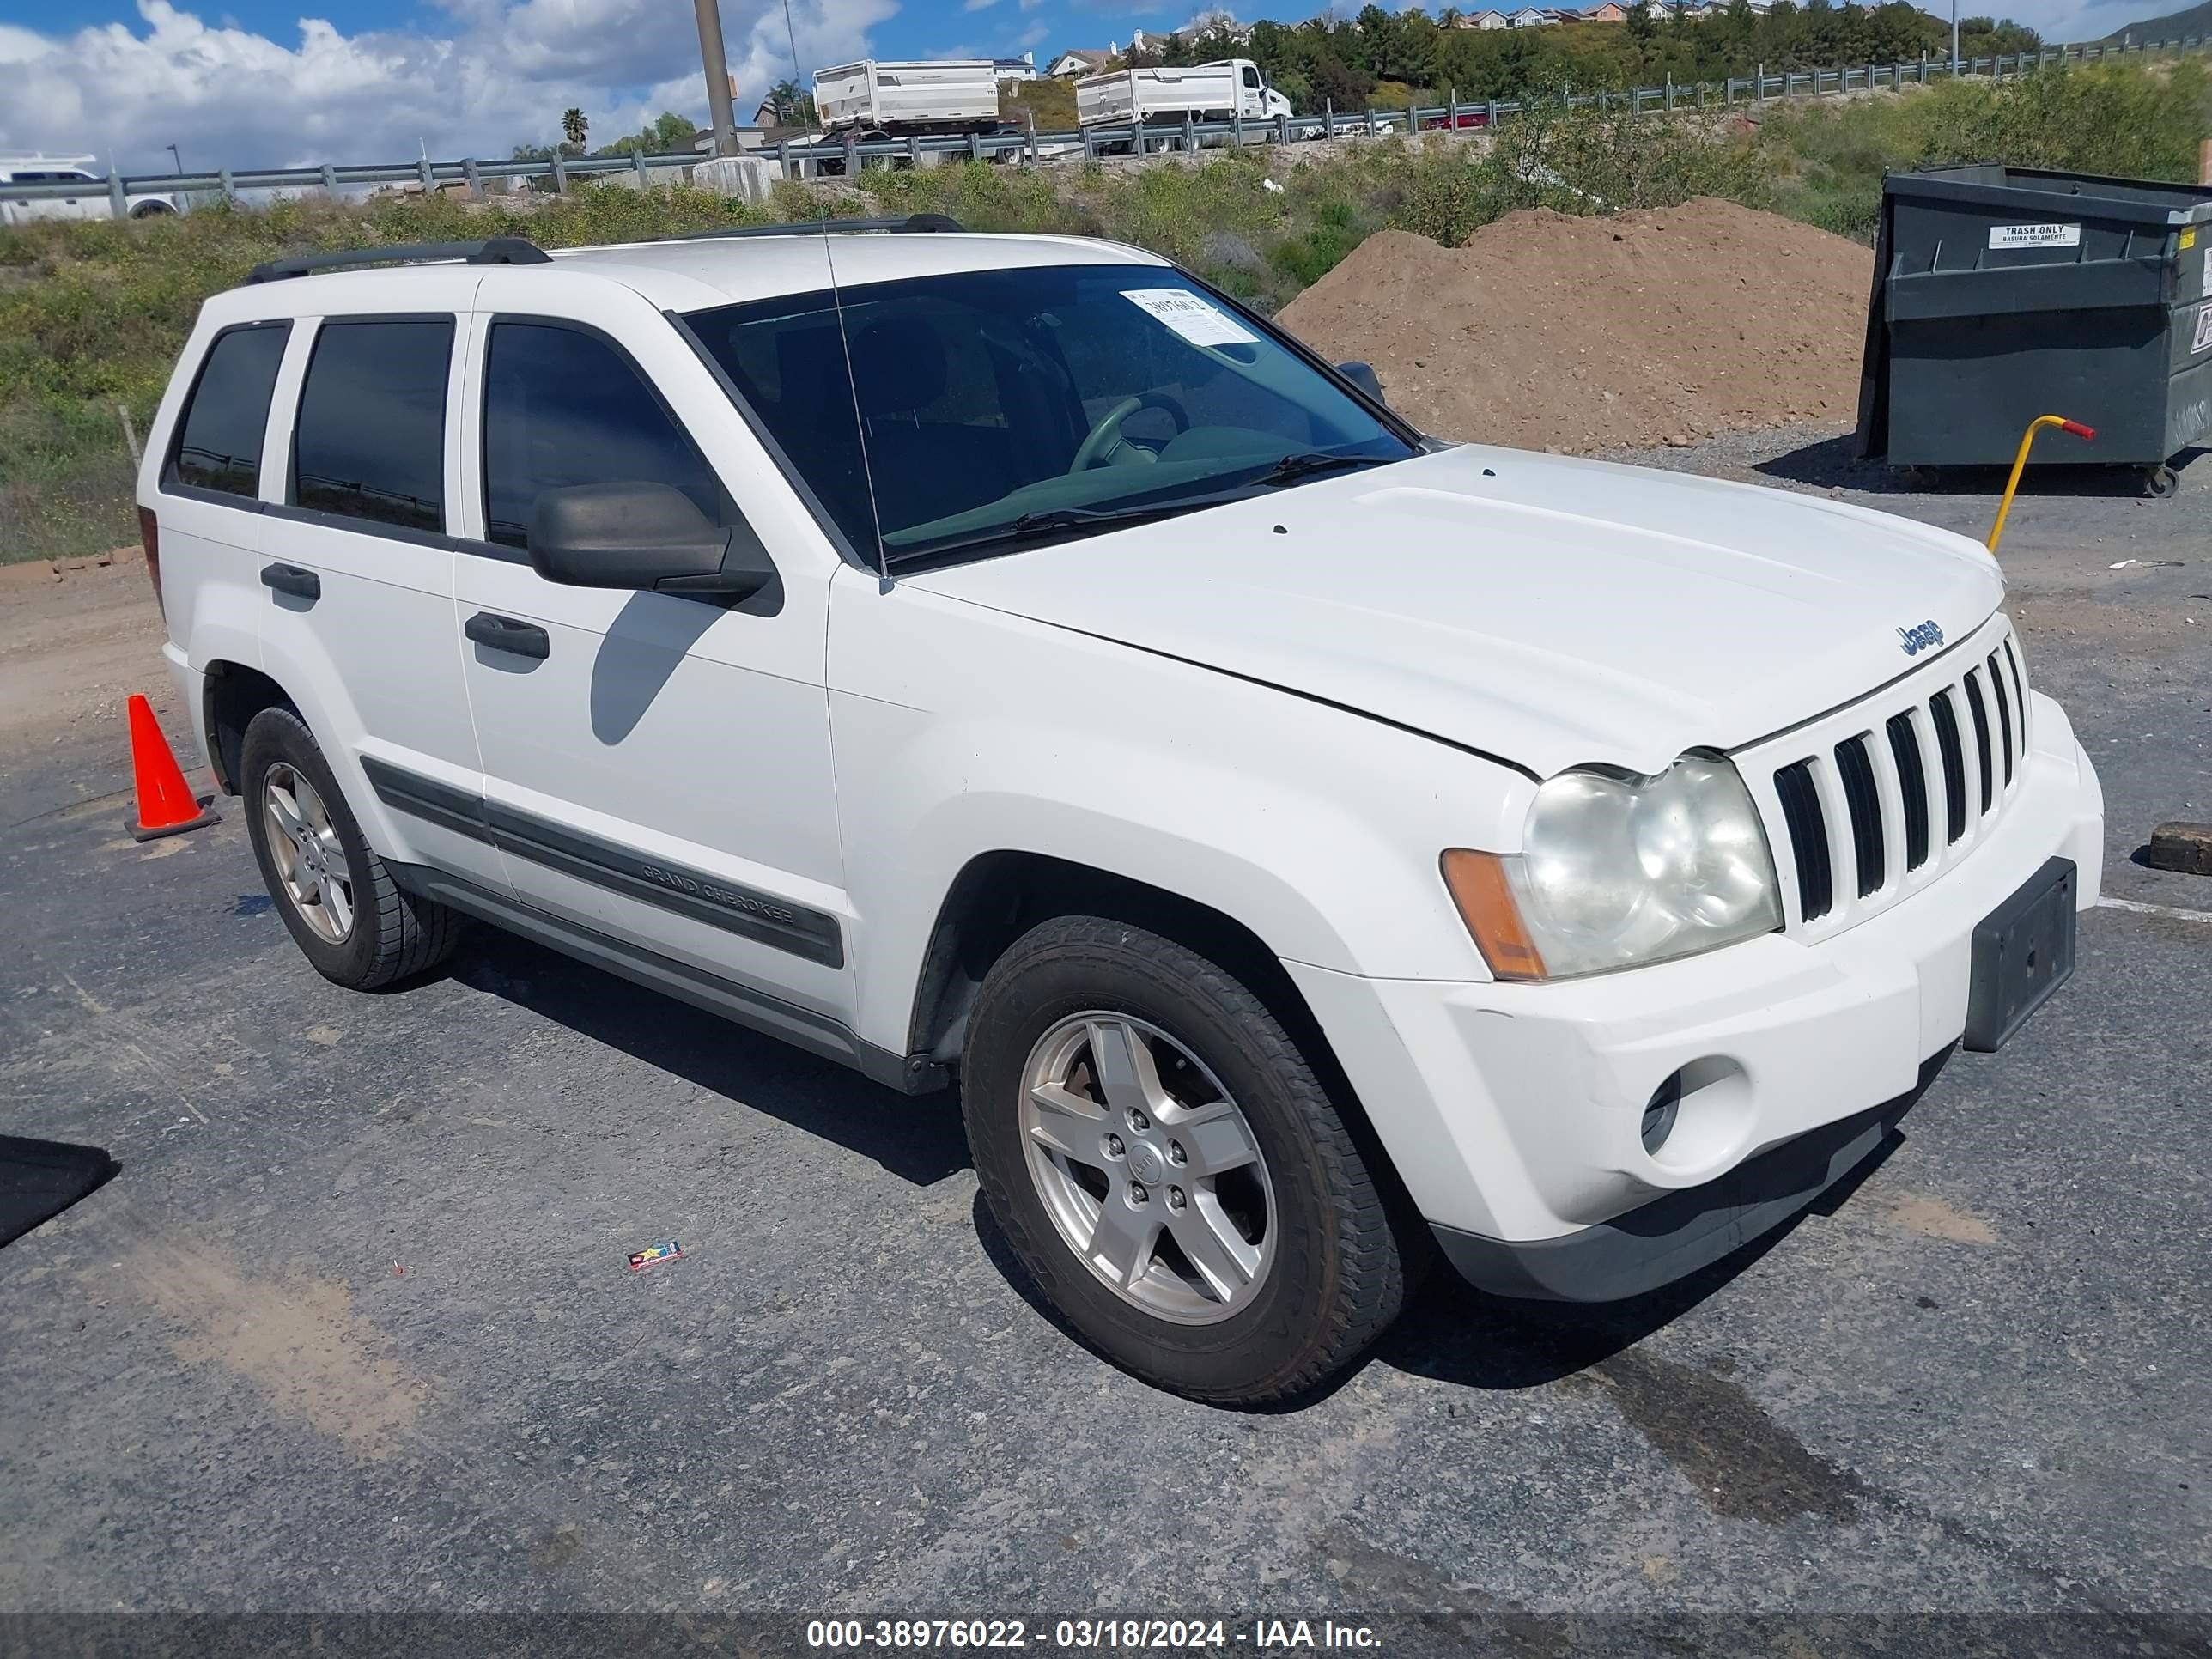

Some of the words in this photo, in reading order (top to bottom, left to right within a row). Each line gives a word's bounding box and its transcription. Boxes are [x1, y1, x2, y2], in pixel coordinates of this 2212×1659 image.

[2006, 226, 2036, 235] TRASH
[2039, 225, 2064, 234] ONLY
[1895, 619, 1944, 656] Jeep
[643, 865, 698, 892] GRAND
[703, 884, 793, 924] CHEROKEE
